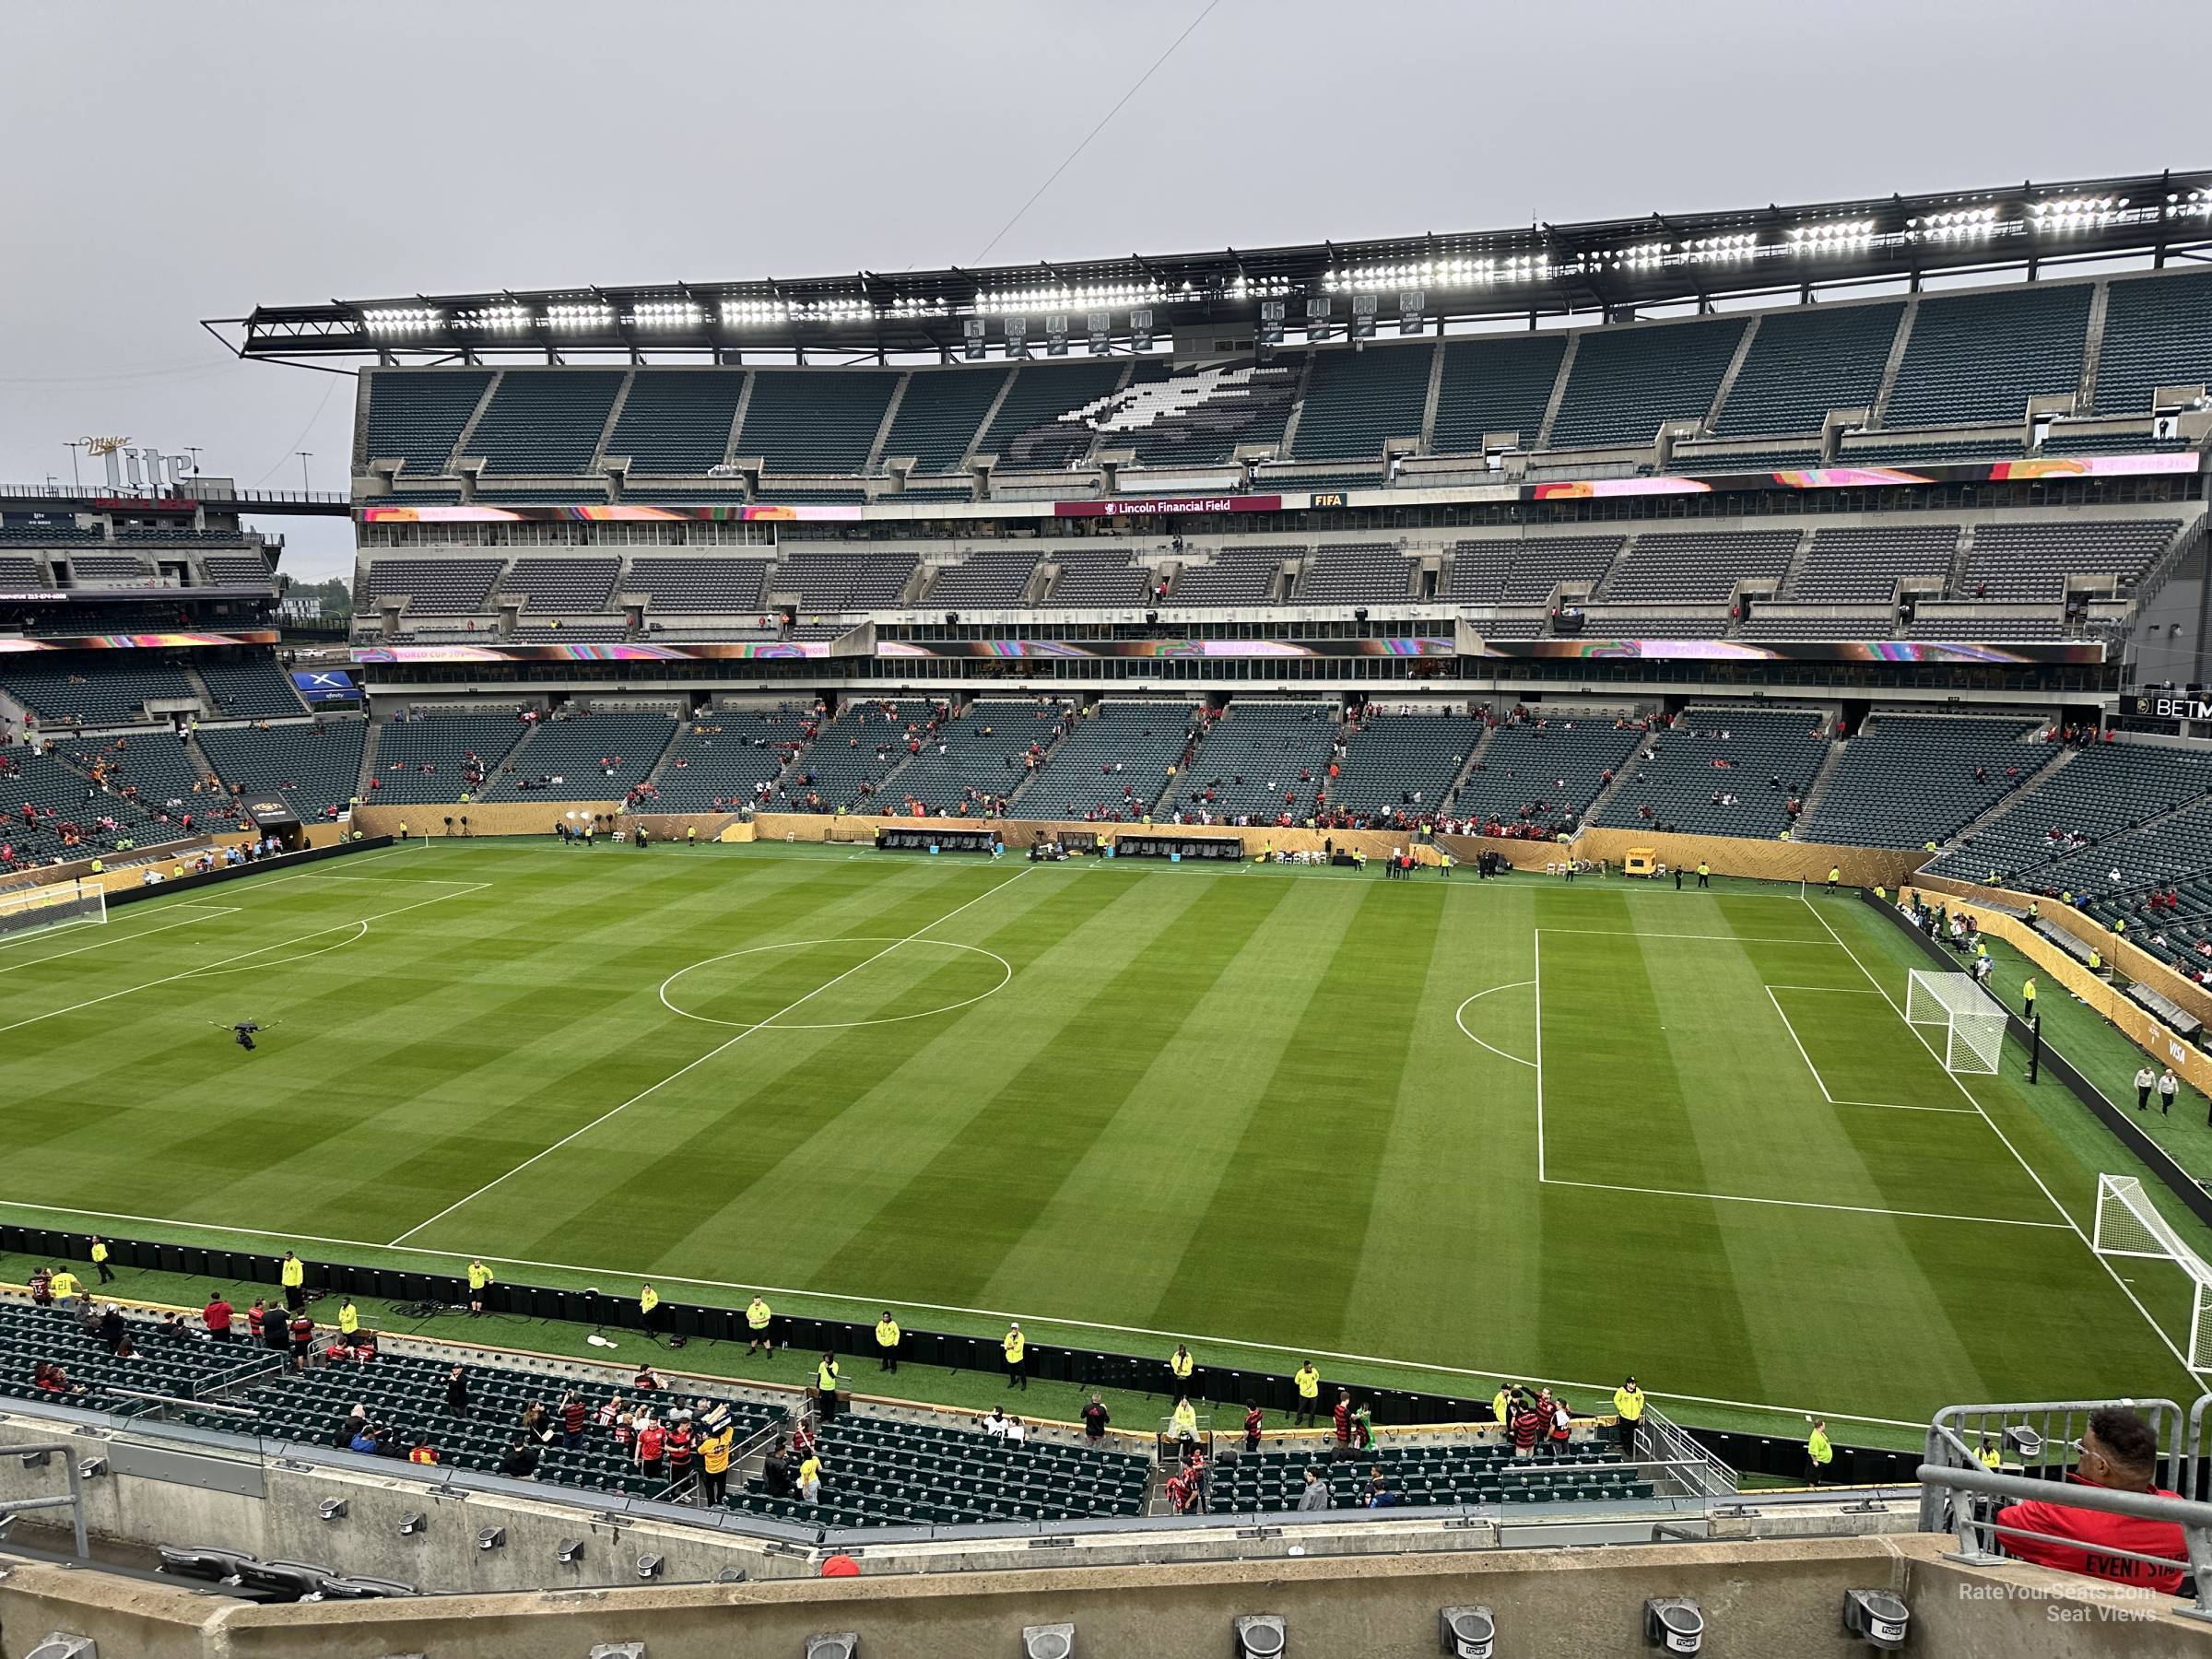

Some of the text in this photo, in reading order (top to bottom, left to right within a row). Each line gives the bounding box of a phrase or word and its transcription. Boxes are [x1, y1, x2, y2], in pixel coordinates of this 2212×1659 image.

[1310, 299, 1328, 318] 40
[1402, 293, 1422, 312] 20
[970, 321, 980, 338] 5
[1132, 311, 1151, 329] 70
[80, 435, 133, 456] Miller
[103, 448, 191, 496] Lite
[1119, 500, 1230, 513] Lincoln Financial Field
[1315, 496, 1342, 506] FIFA
[2169, 1039, 2185, 1065] VISA
[58, 1279, 67, 1291] 21
[2086, 1554, 2140, 1579] EVENT
